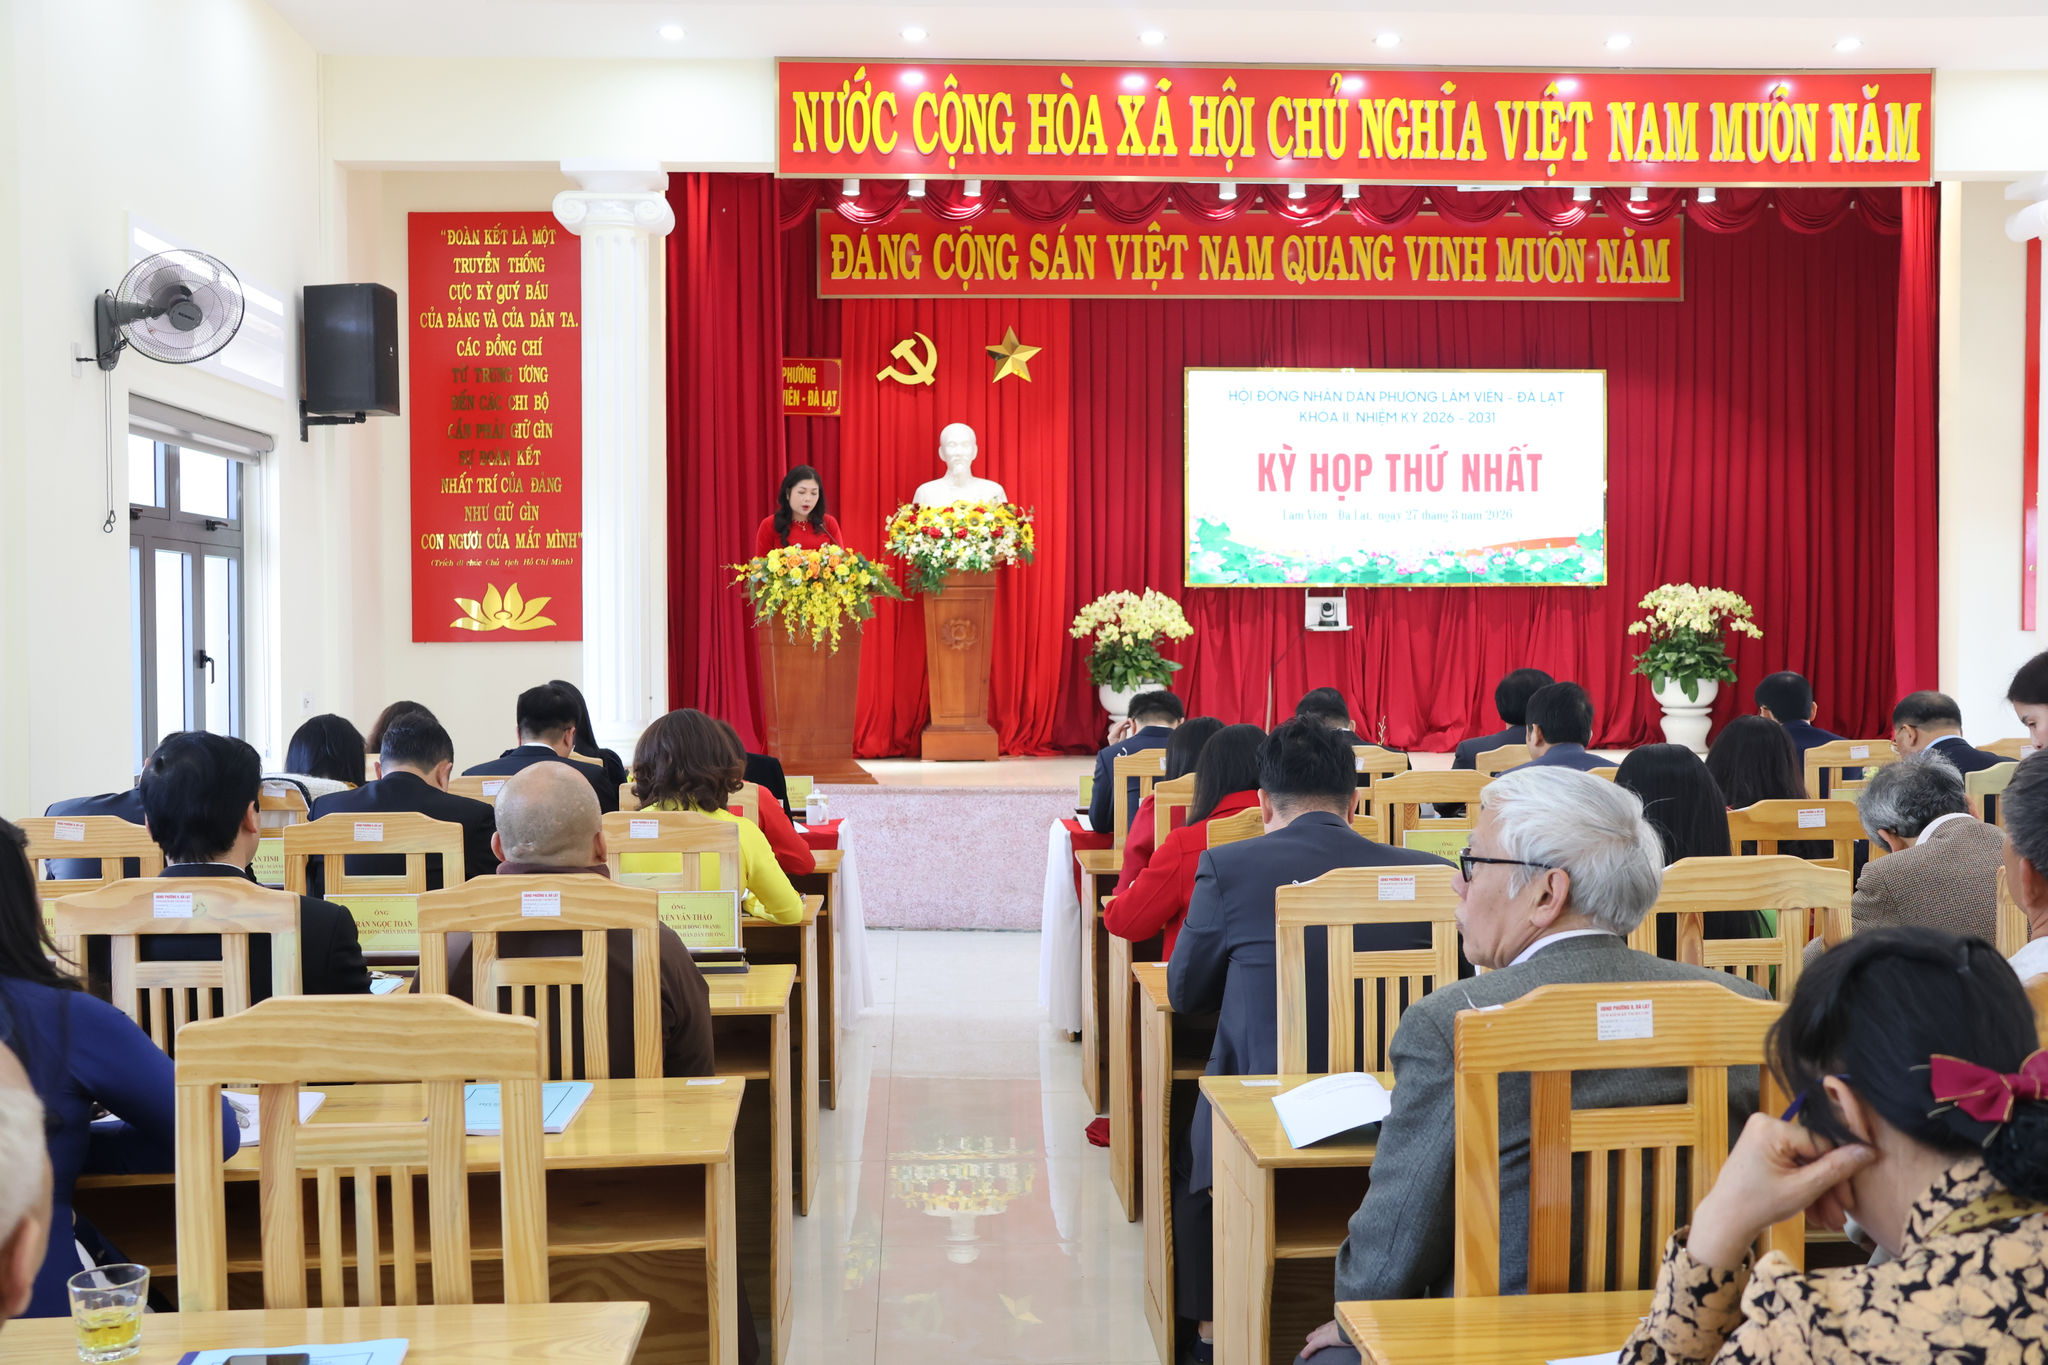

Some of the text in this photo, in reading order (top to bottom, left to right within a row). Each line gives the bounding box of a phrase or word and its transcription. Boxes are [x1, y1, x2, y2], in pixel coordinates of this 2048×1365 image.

[793, 65, 1922, 177] NƯỚC CỘNG HÒA XÃ HỘI CHỦ NGHĨA VIỆT NAM MUÔN NĂM
[484, 222, 508, 245] KẾT
[512, 225, 528, 245] LÀ
[532, 225, 556, 248] MỘT
[453, 250, 546, 274] TRUYỀN THỐNG
[933, 225, 1019, 291] CỘNG
[1106, 220, 1189, 292] VIỆT
[1198, 235, 1275, 282] NAM
[1281, 234, 1396, 285] QUANG
[1403, 235, 1487, 282] VINH
[449, 280, 549, 305] CỰC KỲ QUÝ BÁU
[419, 306, 579, 329] CỦA ĐẢNG VÀ CỦA DÂN TA.
[456, 333, 543, 357] CÁC ĐỒNG CHÍ
[474, 367, 513, 383] TRUNG
[518, 364, 549, 383] ƯƠNG
[782, 363, 816, 384] PHƯỜNG
[480, 391, 503, 411] CÁC
[508, 394, 529, 411] CHI
[533, 390, 550, 414] BỘ
[808, 386, 820, 406] ĐÀ
[822, 390, 837, 411] LẠT
[1228, 386, 1253, 405] HỘI
[533, 419, 553, 439] GÌN
[1423, 411, 1455, 424] 2026
[1468, 411, 1496, 424] 2031
[516, 443, 542, 466] KẾT
[441, 471, 473, 494] NHẤT
[477, 474, 498, 493] TRÍ
[500, 471, 524, 493] CỦA
[1258, 443, 1543, 501] KỲ HỌP THỨ NHẤT
[464, 503, 490, 522] NHƯ
[519, 501, 540, 521] GÌN
[421, 533, 444, 550] CON
[486, 527, 510, 550] CỦA
[515, 525, 541, 549] MẮT
